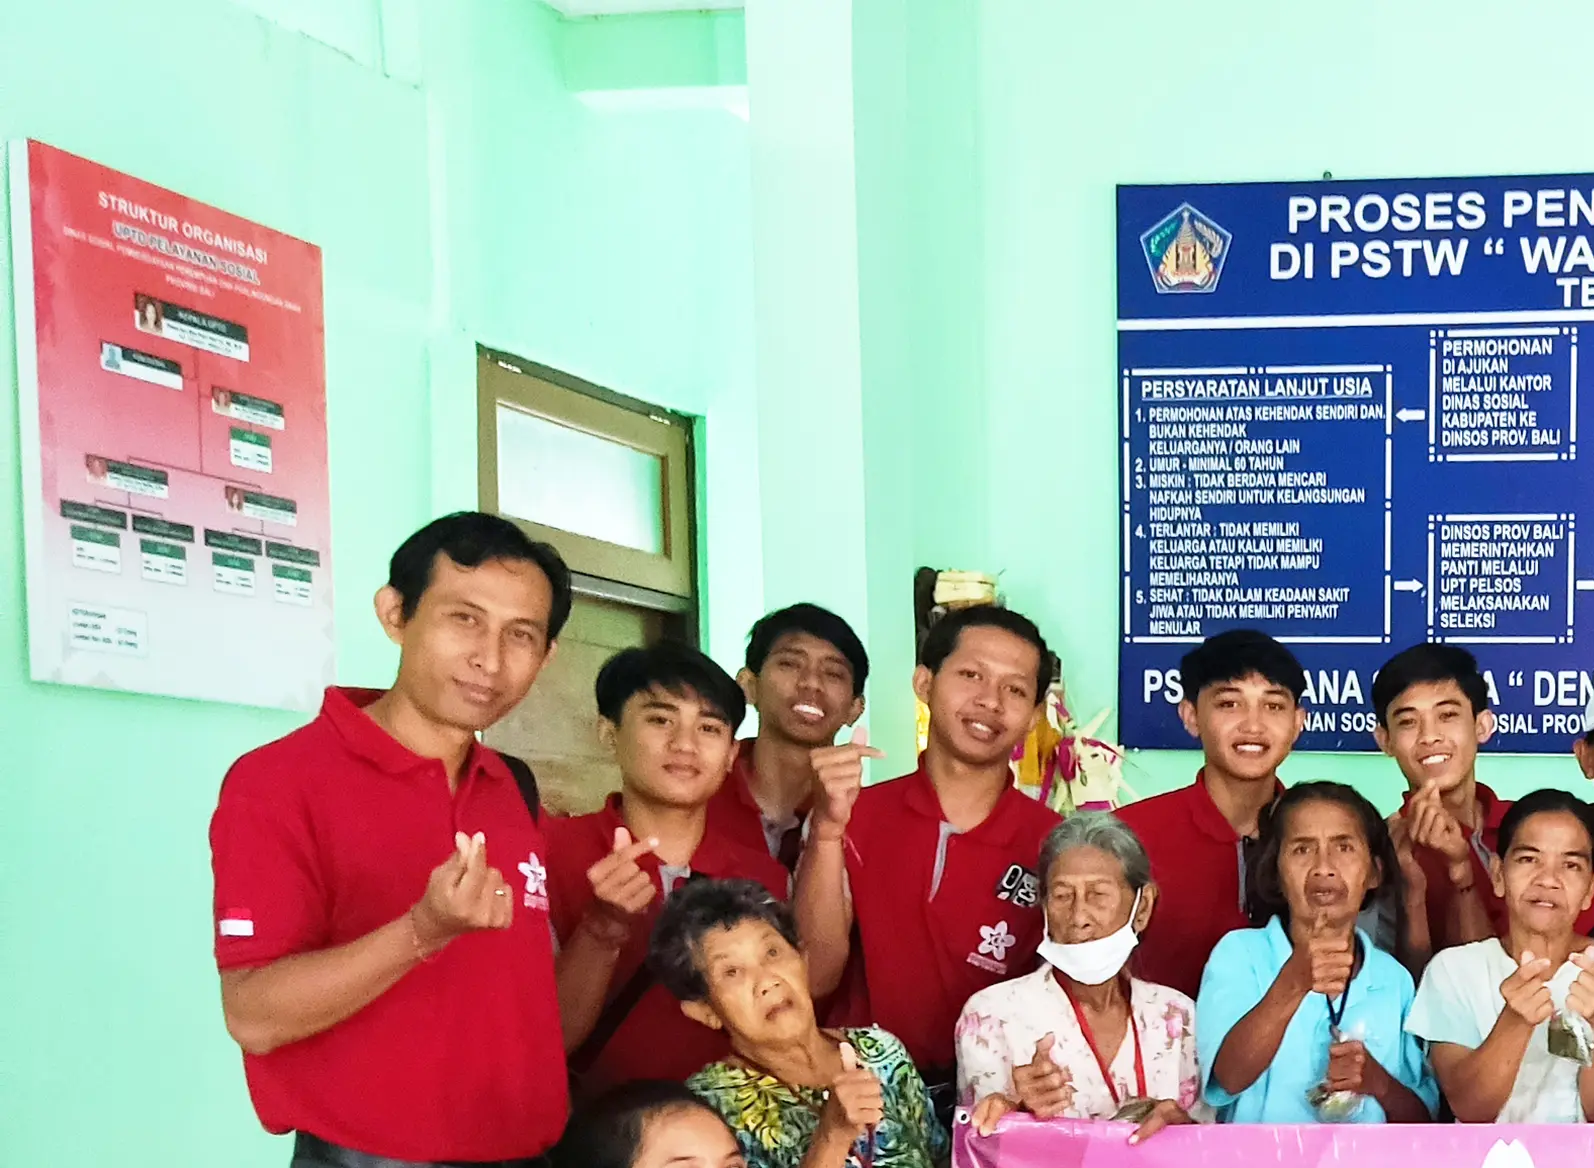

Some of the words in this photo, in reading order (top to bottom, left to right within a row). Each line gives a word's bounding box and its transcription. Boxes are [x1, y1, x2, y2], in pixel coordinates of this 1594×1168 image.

[1289, 193, 1485, 233] PROSES
[98, 191, 179, 233] STRUKTUR
[182, 221, 268, 264] ORGANISASI
[1271, 243, 1313, 279] DI
[1332, 239, 1468, 278] PSTW
[1443, 339, 1552, 356] PERMOHONAN
[1443, 359, 1454, 374] DI
[1458, 358, 1508, 374] AJUKAN
[1142, 380, 1259, 399] PERSYARATAN
[1265, 378, 1328, 398] LANJUT
[1334, 378, 1372, 397] USIA
[1443, 377, 1496, 392] MELALUI
[1500, 375, 1551, 391] KANTOR
[1443, 394, 1479, 410] DINAS
[1484, 394, 1528, 409] SOSIAL
[1150, 408, 1223, 421] PERMOHONAN
[1226, 407, 1252, 420] ATAS
[1255, 406, 1313, 420] KEHENDAK
[1316, 405, 1357, 419] SENDIRI
[1443, 412, 1516, 428] KABUPATEN
[1520, 412, 1536, 426] KE
[1150, 425, 1185, 438] BUKAN
[1189, 424, 1246, 438] KEHENDAK
[1443, 430, 1488, 446] DINSOS
[1492, 430, 1527, 445] PROV.
[1532, 430, 1560, 444] BALI
[1150, 441, 1227, 454] KELUARGANYA
[1235, 440, 1273, 454] ORANG
[1276, 440, 1299, 453] LAIN
[1150, 458, 1179, 471] UMUR
[1189, 457, 1232, 470] MINIMAL
[1235, 457, 1246, 470] 60
[1249, 457, 1283, 470] TAHUN
[1150, 474, 1184, 487] MISKIN
[1194, 474, 1224, 487] TIDAK
[1228, 473, 1276, 487] BERDAYA
[1278, 473, 1326, 486] MENCARI
[1150, 491, 1192, 504] NAFKAH
[1195, 490, 1236, 504] SENDIRI
[1239, 490, 1274, 503] UNTUK
[1277, 489, 1364, 503] KELANGSUNGAN
[1150, 507, 1201, 520] HIDUPNYA
[1150, 523, 1210, 537] TERLANTAR
[1220, 523, 1250, 536] TIDAK
[1253, 523, 1299, 536] MEMILIKI
[1442, 525, 1490, 540] DINSOS
[1494, 525, 1530, 539] PROV
[1534, 524, 1563, 539] BALI
[1150, 540, 1206, 553] KELUARGA
[1209, 540, 1235, 553] ATAU
[1238, 539, 1273, 552] KALAU
[1277, 539, 1322, 552] MEMILIKI
[1442, 542, 1553, 557] MEMERINTAHKAN
[1150, 556, 1206, 569] KELUARGA
[1210, 556, 1244, 569] TETAPI
[1248, 556, 1278, 569] TIDAK
[1281, 555, 1319, 568] MAMPU
[1442, 561, 1478, 575] PANTI
[1482, 560, 1538, 575] MELALUI
[1150, 572, 1238, 585] MEMELIHARANYA
[1441, 578, 1466, 592] UPT
[1470, 578, 1521, 592] PELSOS
[1150, 589, 1183, 602] SEHAT
[1192, 589, 1223, 601] TIDAK
[1226, 589, 1262, 601] DALAM
[1265, 588, 1315, 601] KEADAAN
[1319, 588, 1349, 601] SAKIT
[1441, 596, 1549, 610] MELAKSANAKAN
[1150, 605, 1174, 618] JIWA
[1177, 605, 1202, 618] ATAU
[1206, 605, 1236, 618] TIDAK
[1240, 605, 1284, 618] MEMILIKI
[1288, 605, 1338, 618] PENYAKIT
[1150, 621, 1200, 634] MENULAR
[1441, 613, 1494, 627] SELEKSI
[1300, 669, 1364, 704] ANA
